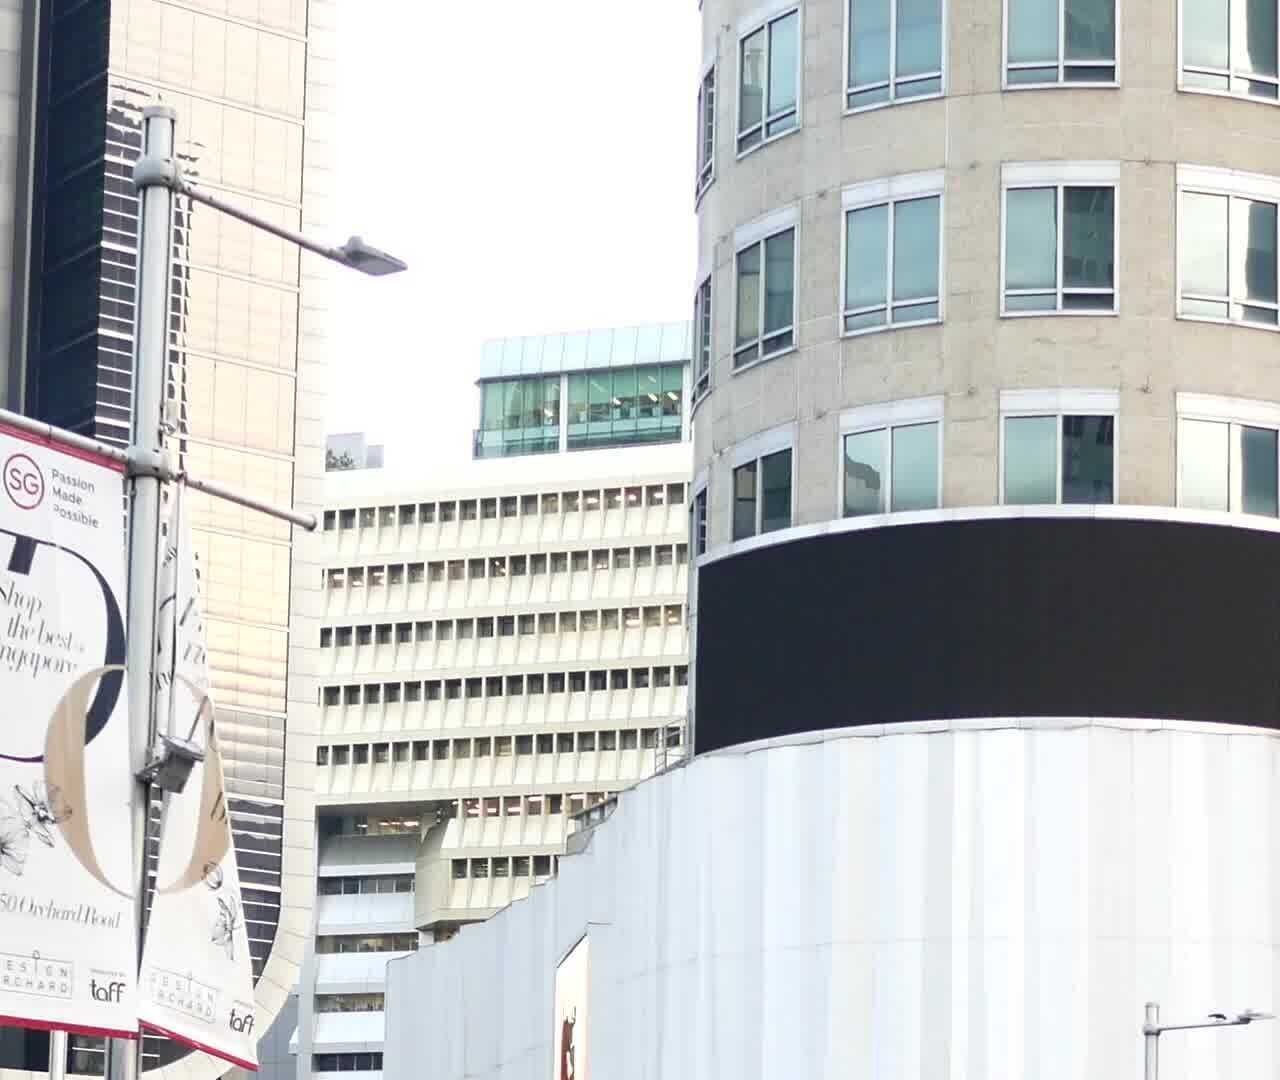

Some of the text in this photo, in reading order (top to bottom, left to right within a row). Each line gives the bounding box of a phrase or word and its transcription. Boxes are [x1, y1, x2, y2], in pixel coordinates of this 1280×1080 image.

[9, 467, 40, 496] SG
[51, 468, 95, 493] Passion
[52, 486, 83, 506] Made
[53, 503, 99, 529] Possible
[6, 613, 35, 640] the
[37, 618, 73, 652] best
[90, 978, 126, 1003] taff
